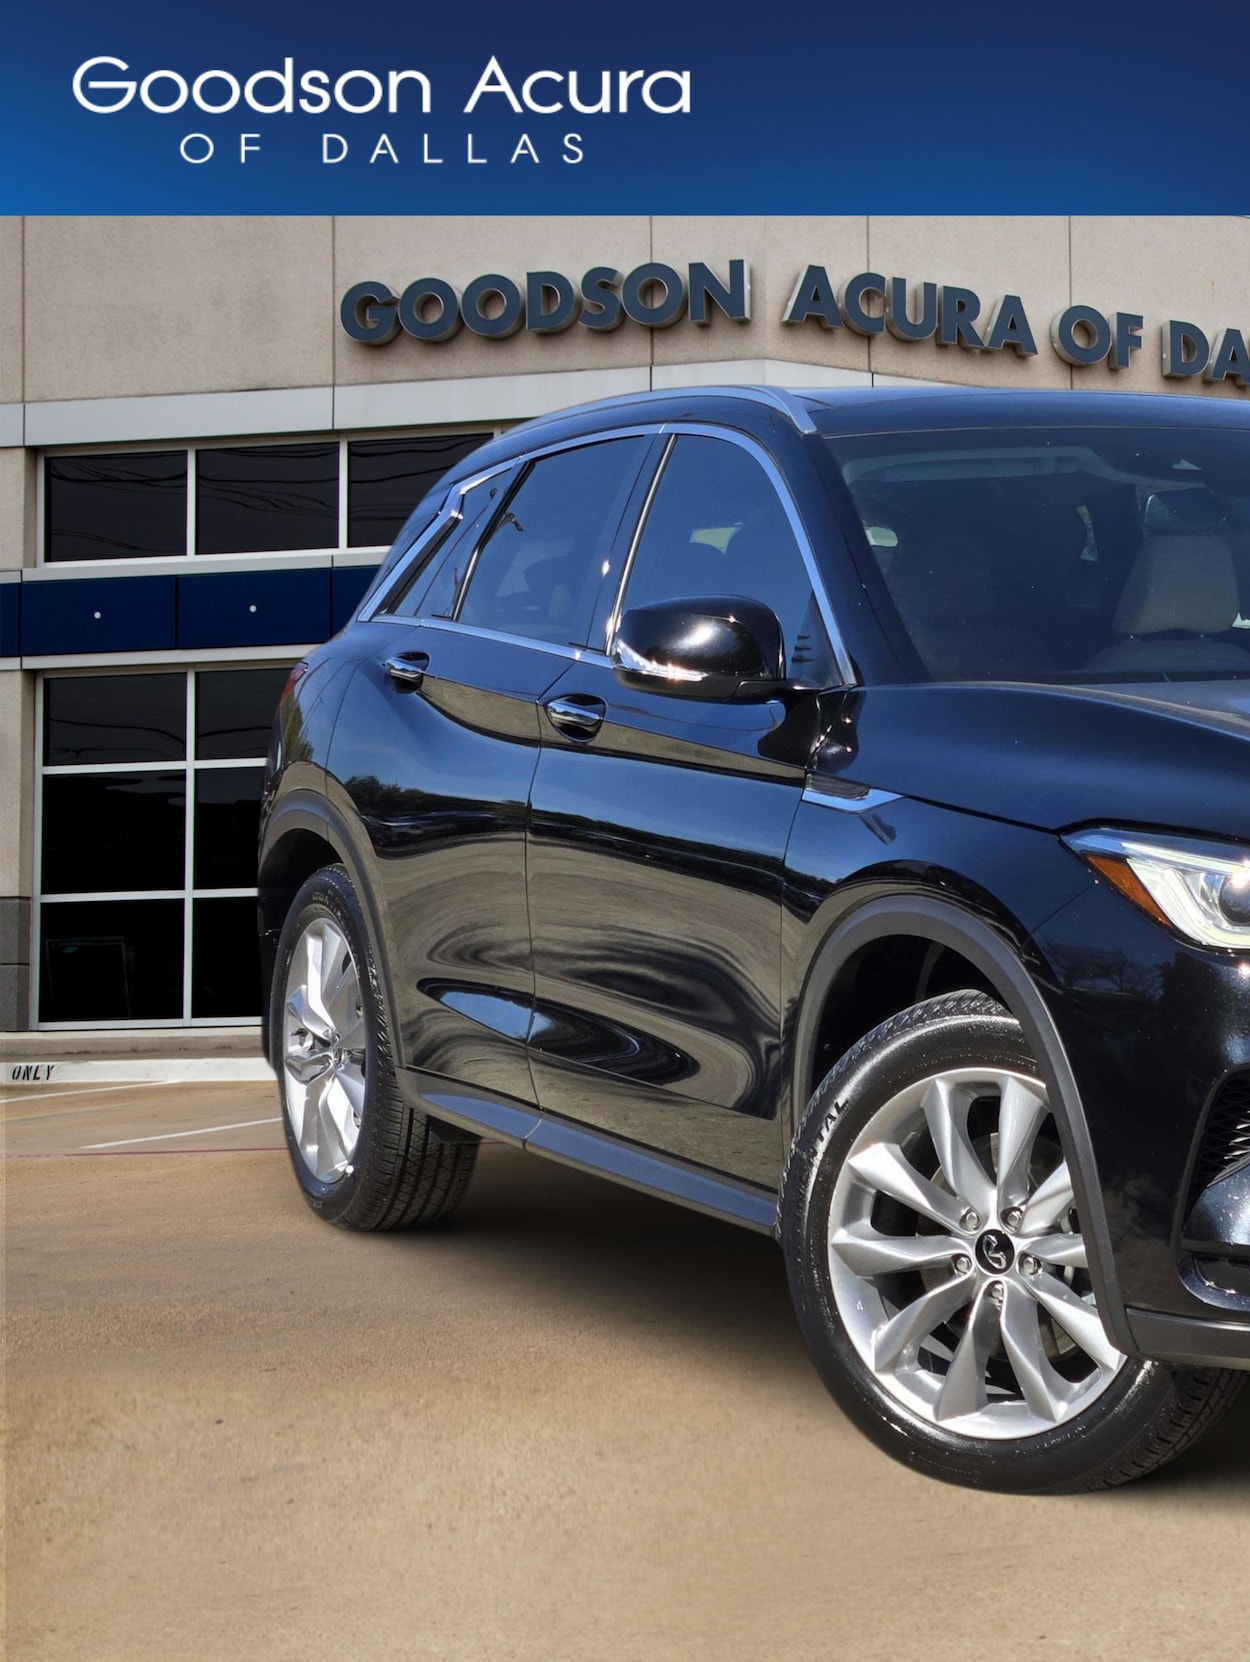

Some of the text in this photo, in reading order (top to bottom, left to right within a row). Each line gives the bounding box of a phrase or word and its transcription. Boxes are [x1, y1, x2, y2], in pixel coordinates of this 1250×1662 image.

[340, 258, 751, 344] GOODSON
[782, 264, 1038, 356] ACURA
[1051, 304, 1143, 368] OF
[11, 1063, 56, 1081] ONLY
